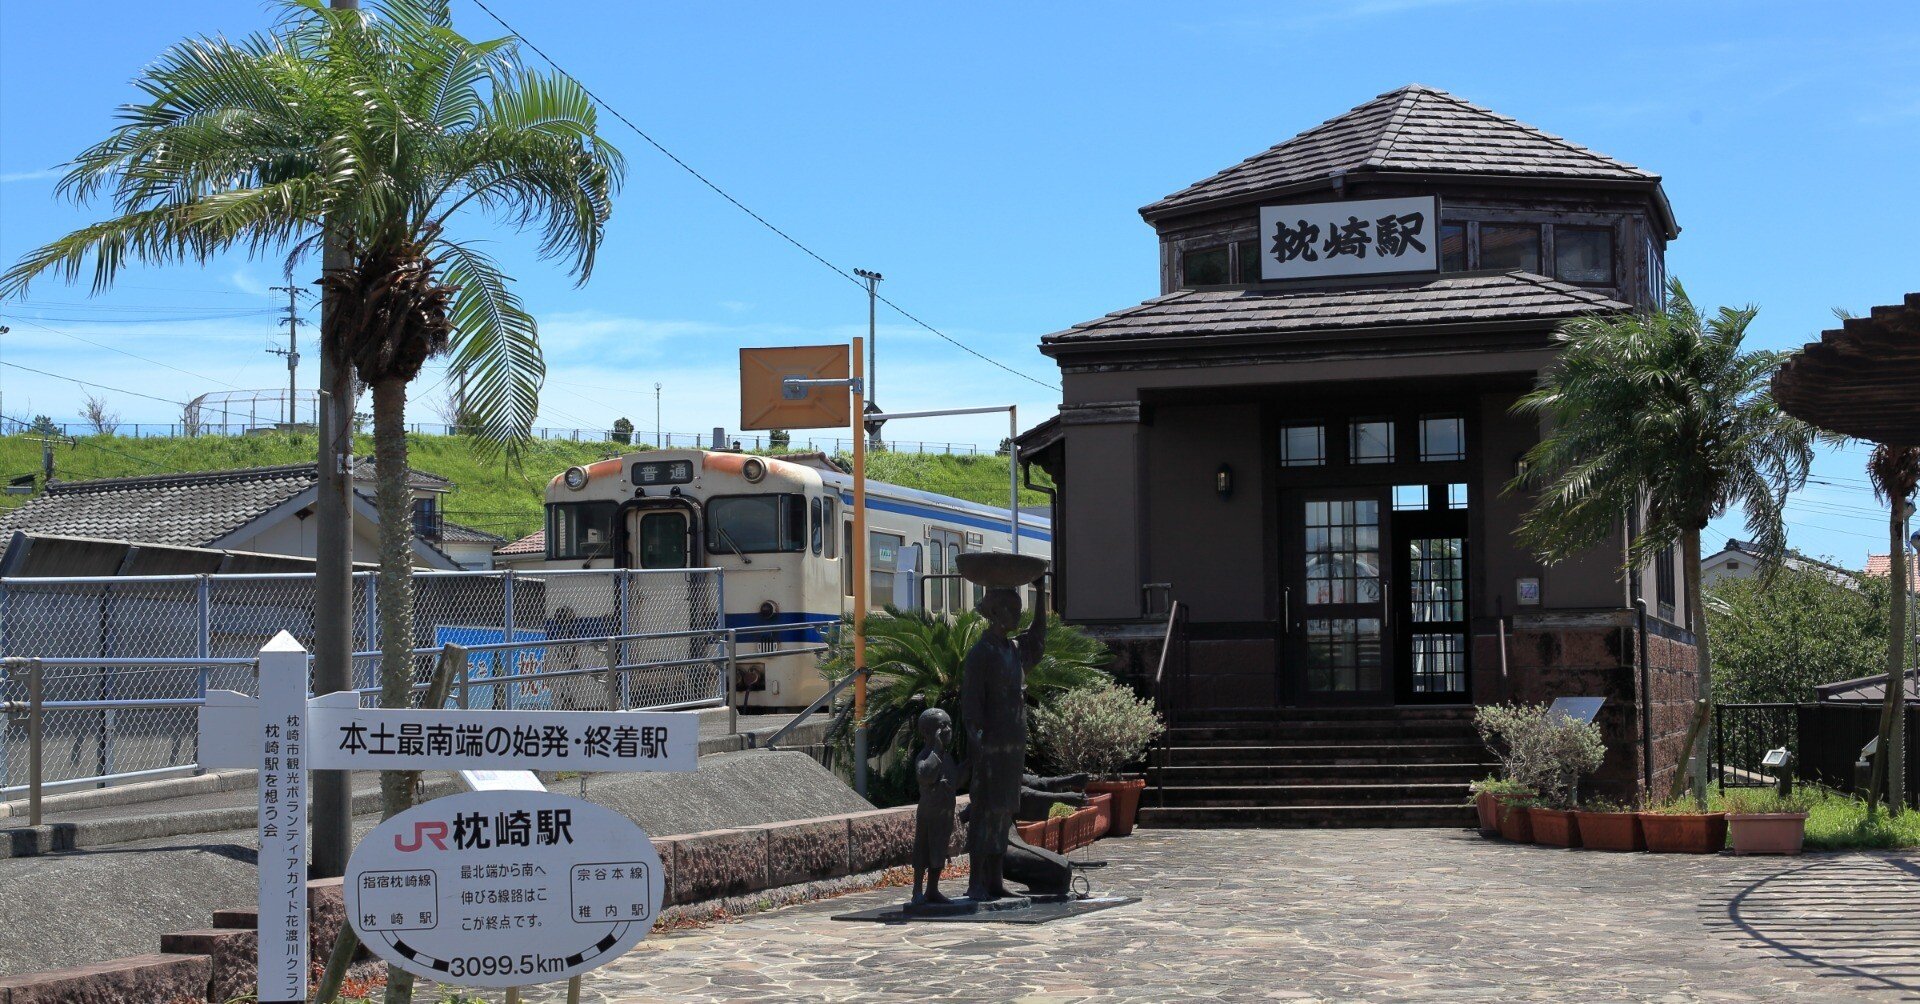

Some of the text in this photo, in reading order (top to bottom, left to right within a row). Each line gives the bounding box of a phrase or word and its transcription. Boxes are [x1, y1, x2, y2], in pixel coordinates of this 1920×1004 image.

[1270, 211, 1427, 264] 枕崎駅
[640, 464, 687, 482] 普通
[339, 722, 668, 759] 本土最南端の始発・終着駅
[263, 723, 280, 838] 枕崎駅を想う会
[394, 808, 574, 853] JR 枕崎駅
[285, 714, 300, 999] 枕崎市観光ボランティアガイド花渡川クラブ
[460, 863, 547, 879] 最北端から南へ
[576, 867, 643, 882] 宗谷本線
[363, 875, 431, 889] 指宿枕崎線
[461, 887, 548, 906] 伸びる線路はこ
[363, 911, 433, 927] 枕崎駅
[578, 903, 645, 919] 稚内駅
[461, 914, 543, 931] こが終点です。
[450, 954, 566, 978] 3099.5km
